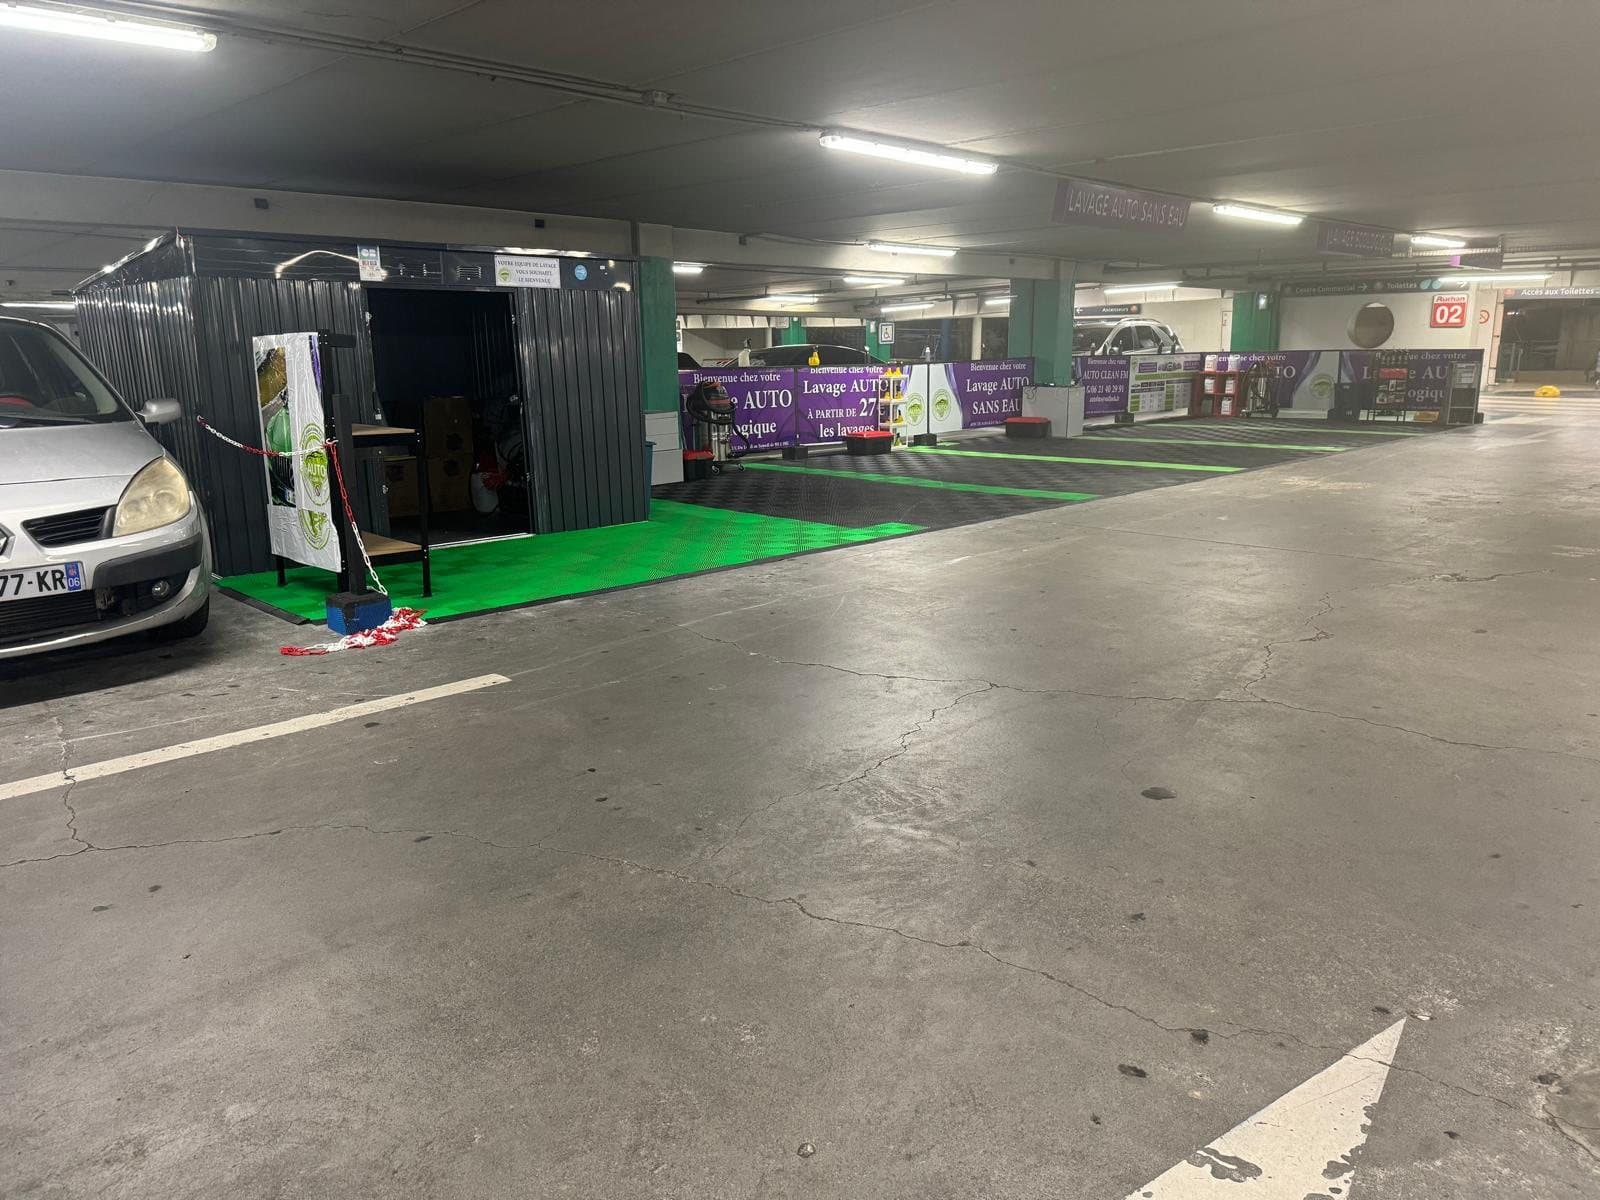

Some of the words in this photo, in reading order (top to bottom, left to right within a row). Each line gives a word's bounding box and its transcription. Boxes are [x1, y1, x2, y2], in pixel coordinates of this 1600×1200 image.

[1068, 189, 1109, 216] LAVAGE
[1111, 196, 1138, 220] AUTO
[1141, 201, 1167, 224] SANS
[1168, 206, 1185, 226] EAU
[1561, 287, 1594, 296] Toilettes
[1435, 295, 1466, 303] Auchan
[1435, 305, 1463, 324] 02
[1248, 353, 1265, 361] chez
[1266, 353, 1287, 361] votre
[1421, 351, 1440, 360] chez
[1443, 352, 1467, 360] votre
[810, 366, 846, 374] Bienvenue
[848, 366, 864, 374] chez
[866, 366, 883, 374] votre
[970, 362, 998, 372] Bienvenue
[1000, 362, 1012, 370] chez
[1012, 362, 1027, 370] votre
[693, 372, 738, 383] Bienvenue
[740, 371, 758, 382] chez
[759, 373, 781, 382] votre
[1084, 370, 1100, 380] AUTO
[1101, 369, 1120, 379] CLEAN
[803, 380, 847, 398] Lavage
[850, 378, 889, 393] AUTO
[966, 378, 998, 395] Lavage
[1000, 376, 1030, 391] AUTO
[743, 389, 793, 410] AUTO
[972, 399, 1000, 415] SANS
[1001, 398, 1021, 413] EAU
[807, 408, 813, 419] À
[815, 408, 845, 419] PARTIR
[846, 407, 857, 418] DE
[820, 423, 834, 438] les
[837, 422, 875, 437] lavages
[68, 577, 81, 587] 06
